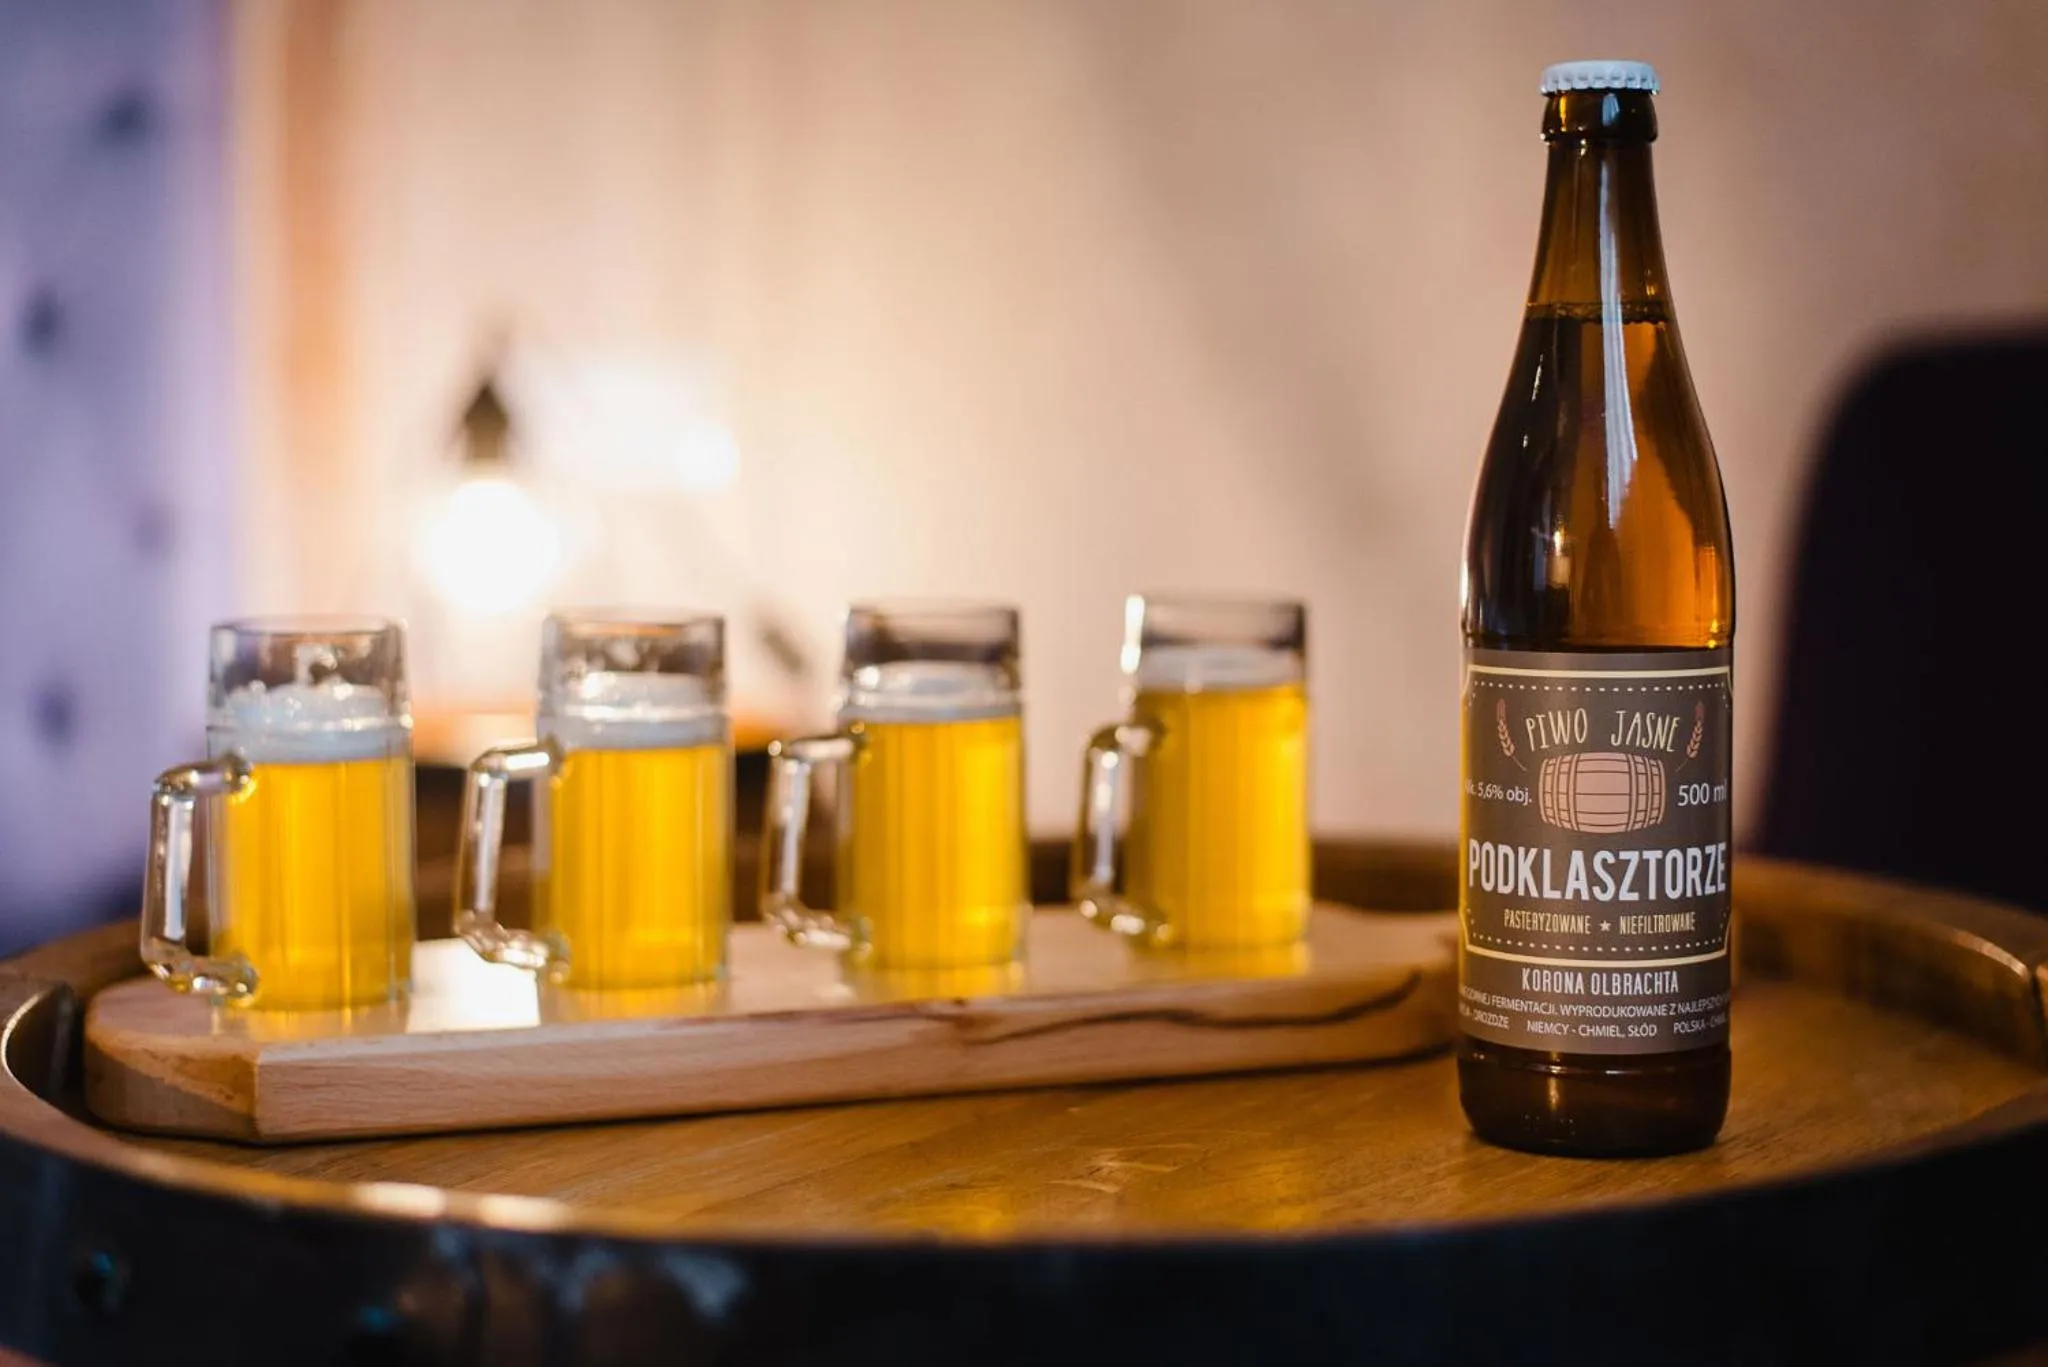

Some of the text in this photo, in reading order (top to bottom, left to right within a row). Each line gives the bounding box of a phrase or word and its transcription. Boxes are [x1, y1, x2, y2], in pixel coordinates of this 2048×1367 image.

[1526, 707, 1680, 752] PIWO JASNE
[1478, 781, 1504, 800] 5,6%
[1506, 785, 1532, 806] obj.
[1677, 782, 1710, 806] 500
[1468, 838, 1727, 901] PODKLASZTORZE
[1503, 908, 1696, 935] PASTERYZOWANE NIEFILTROWANE
[1521, 968, 1679, 996] KORONA OLBRACHTA
[1559, 1002, 1668, 1018] WYPRODUKOWANE
[1669, 1003, 1676, 1016] Z
[1527, 1020, 1570, 1036] NIEMCY
[1627, 1022, 1657, 1037] SŁÓD
[1673, 1019, 1706, 1034] POLSKA
